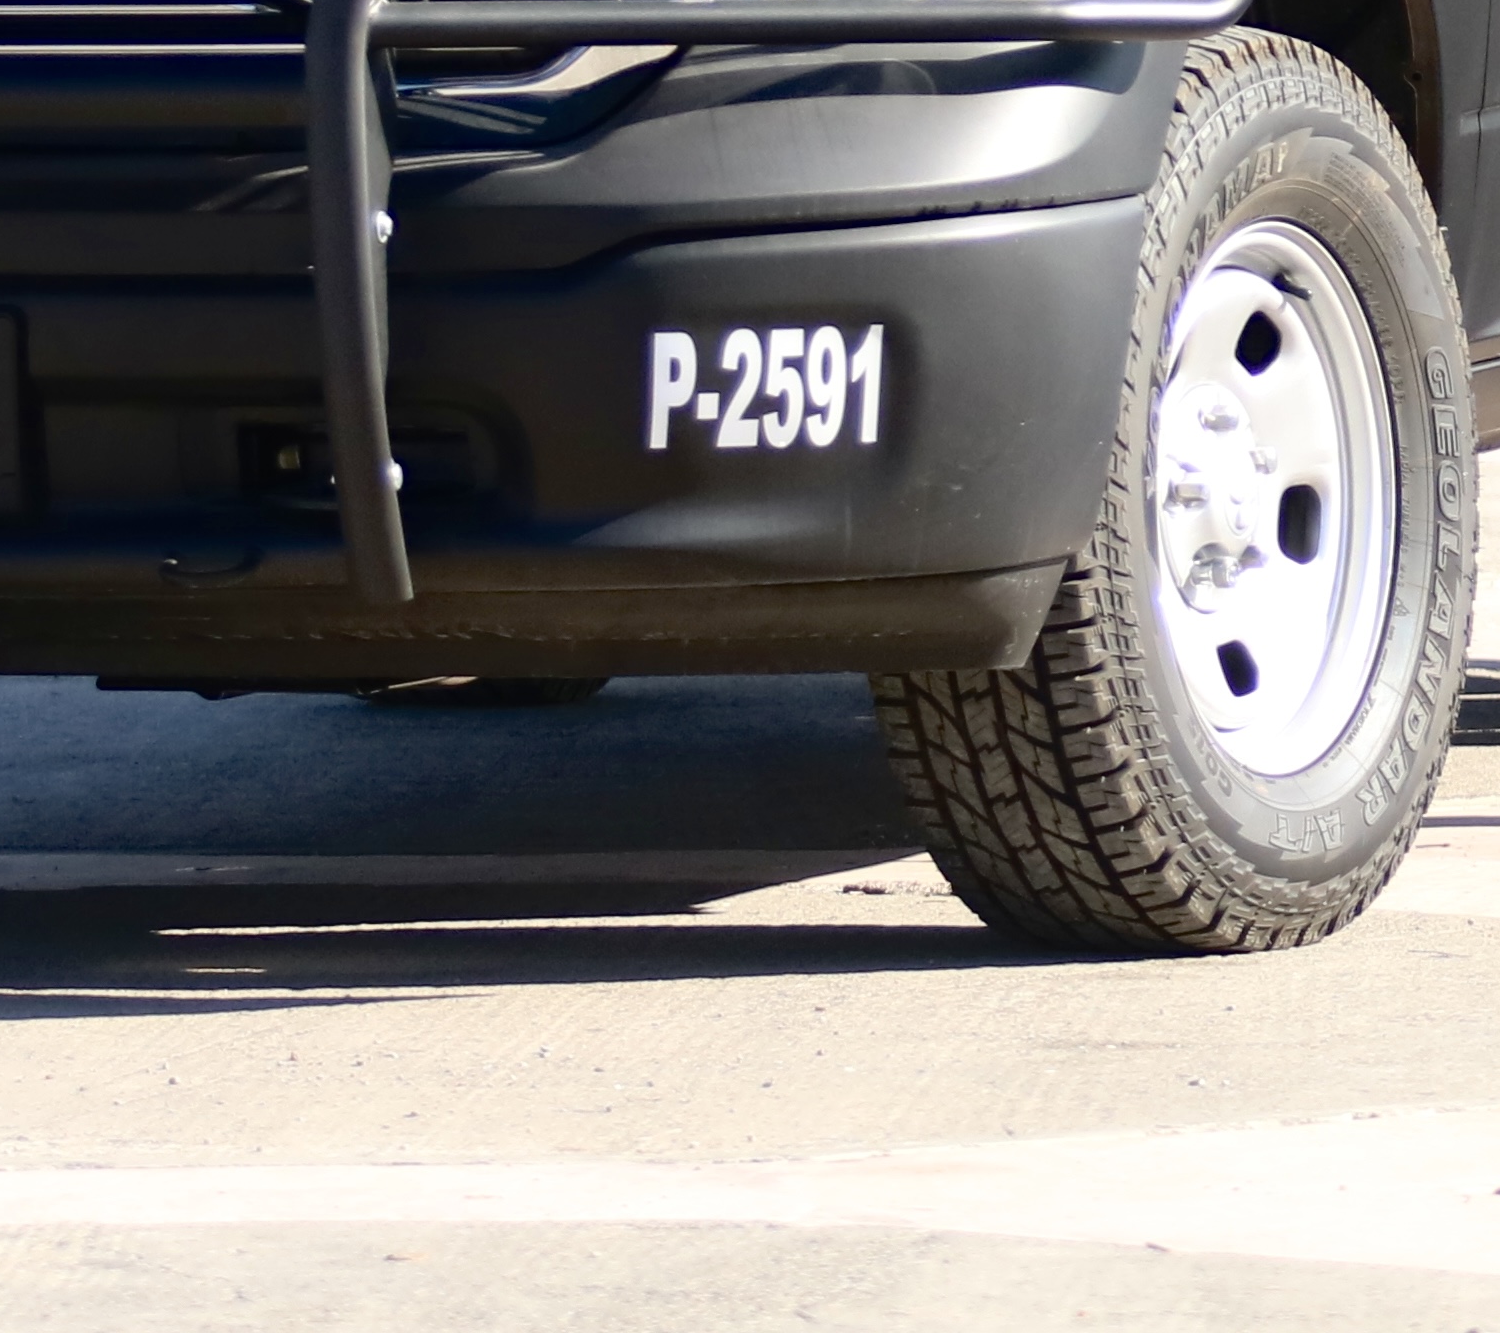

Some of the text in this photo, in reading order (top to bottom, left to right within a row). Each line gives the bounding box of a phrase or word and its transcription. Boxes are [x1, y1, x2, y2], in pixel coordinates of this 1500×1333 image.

[650, 324, 884, 449] P-2591
[1355, 345, 1461, 826] GEOLANDAR
[1268, 810, 1346, 853] A/T
